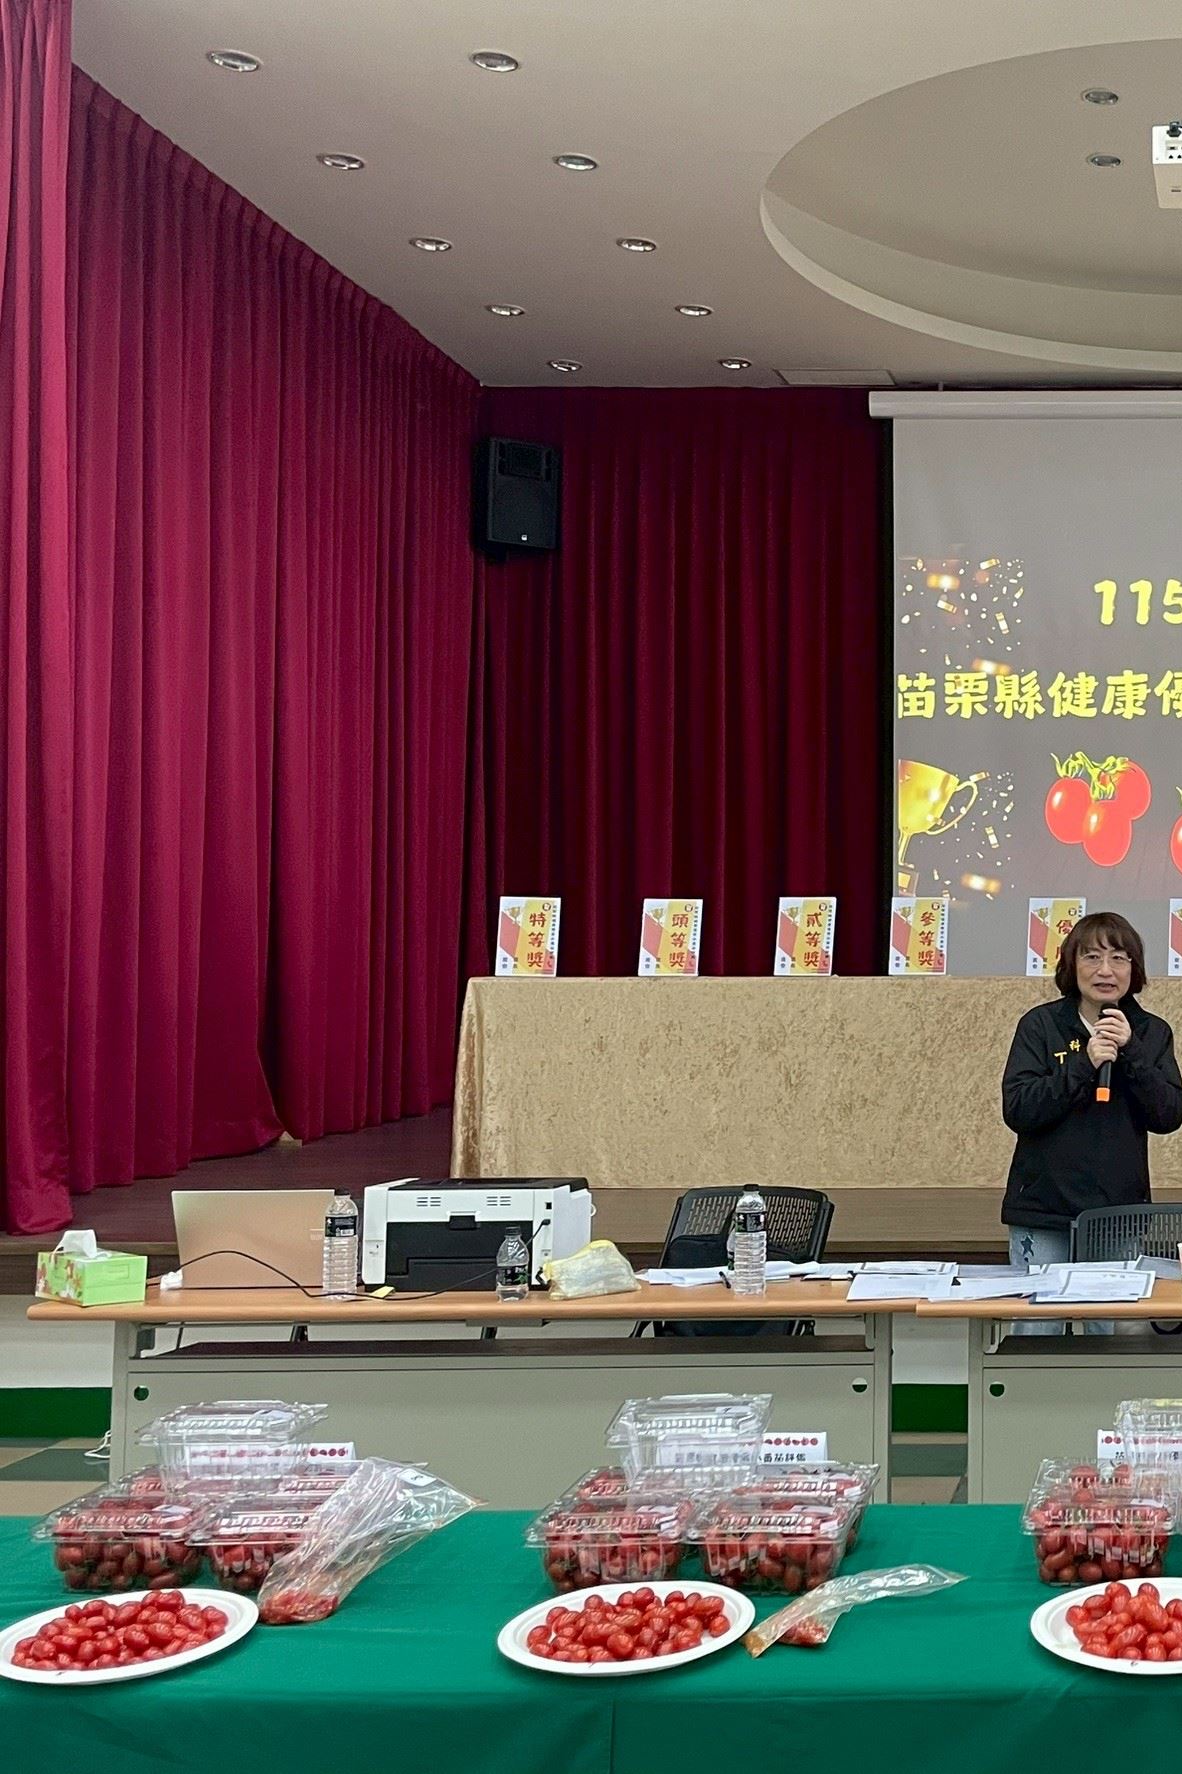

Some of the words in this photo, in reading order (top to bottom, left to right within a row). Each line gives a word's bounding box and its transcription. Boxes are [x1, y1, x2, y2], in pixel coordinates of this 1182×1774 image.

[526, 911, 547, 968] 特等獎
[668, 913, 689, 968] 頭等獎
[803, 911, 823, 967] 貳等獎
[917, 911, 936, 967] 參等獎
[1055, 919, 1075, 960] 優
